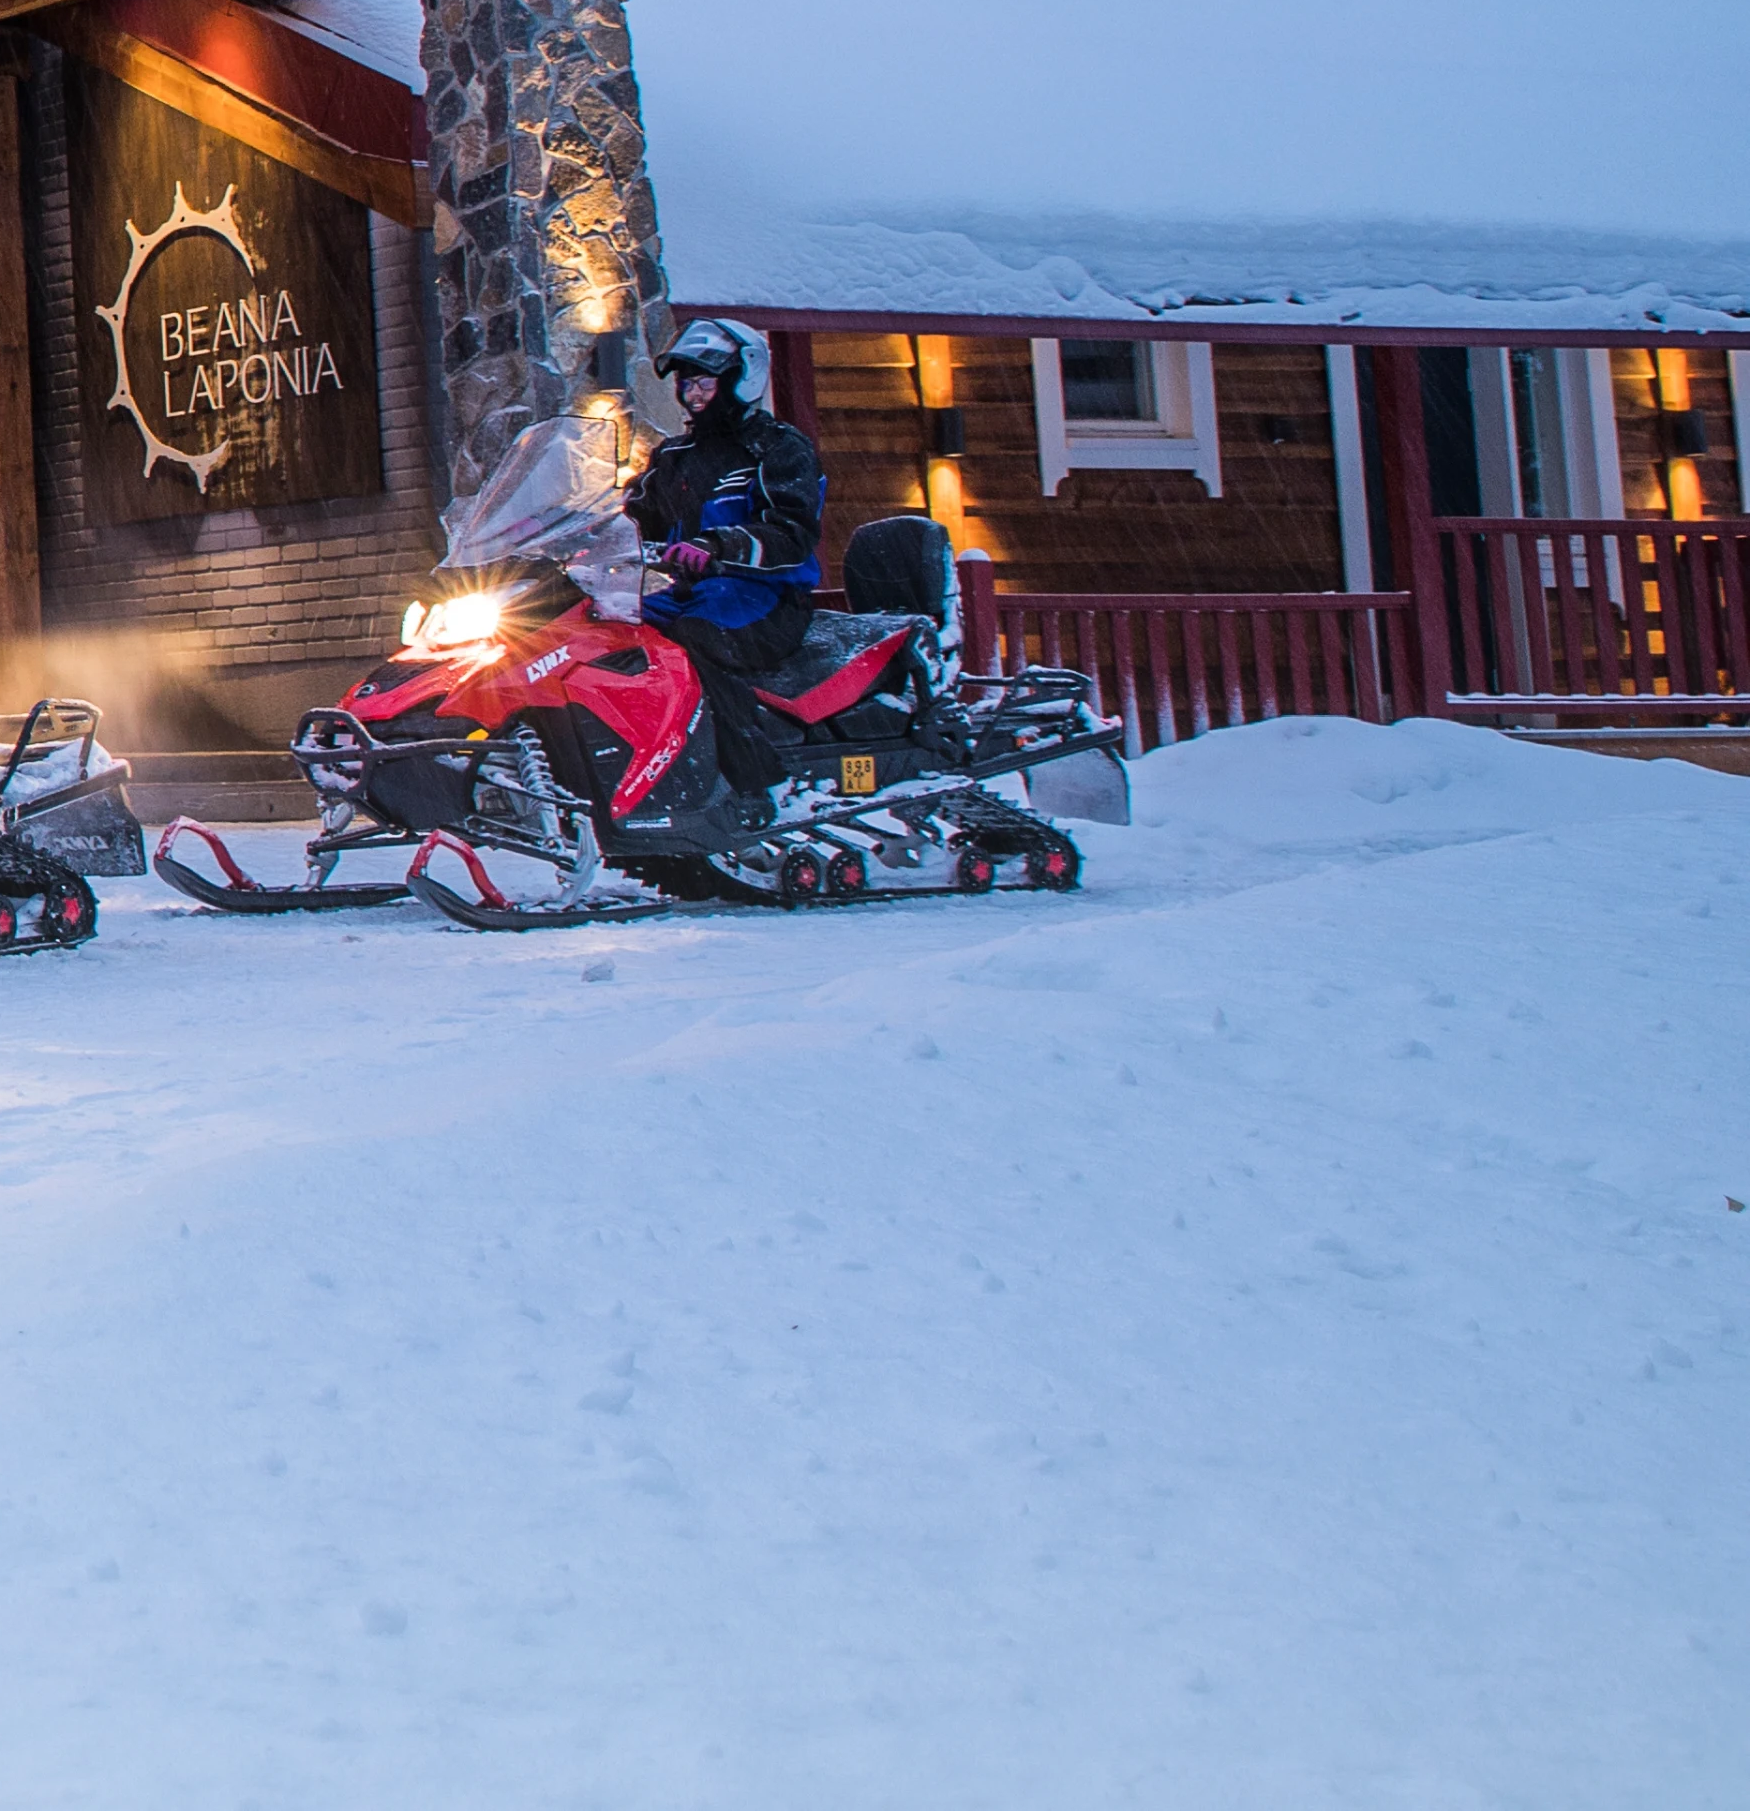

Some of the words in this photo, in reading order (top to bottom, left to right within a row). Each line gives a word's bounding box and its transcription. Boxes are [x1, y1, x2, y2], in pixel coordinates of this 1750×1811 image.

[160, 289, 302, 361] BEANA
[163, 342, 345, 418] LAPONIA
[526, 645, 571, 684] LYNX
